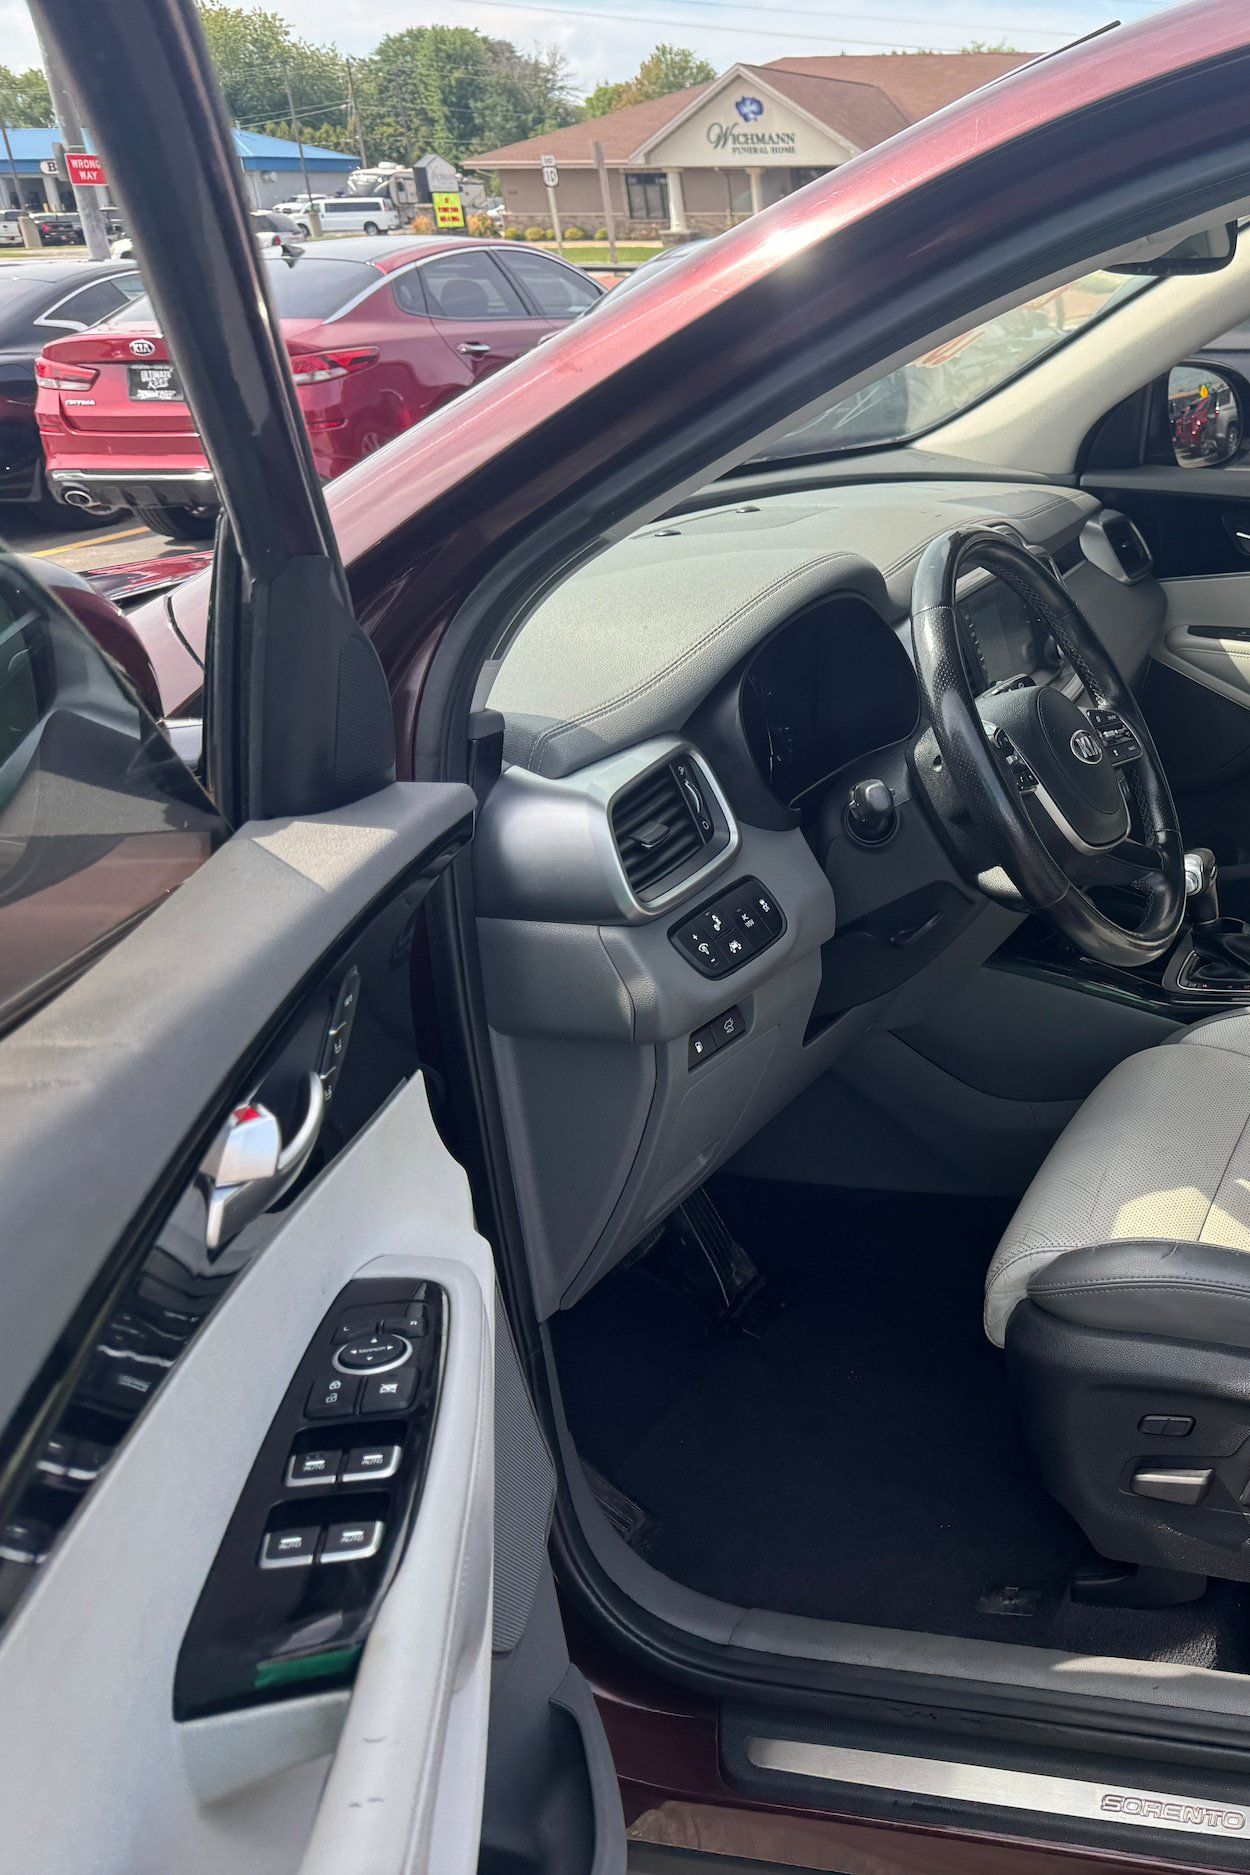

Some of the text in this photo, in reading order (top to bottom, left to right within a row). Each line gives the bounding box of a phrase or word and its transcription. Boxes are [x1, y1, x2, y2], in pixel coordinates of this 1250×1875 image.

[79, 170, 98, 180] WAY
[132, 342, 153, 354] KIA
[361, 1457, 383, 1465] AUTO
[303, 1463, 326, 1472] AUTO
[341, 1534, 364, 1543] AUTO
[278, 1541, 302, 1550] AUTO
[1101, 1793, 1247, 1831] SORENTO
